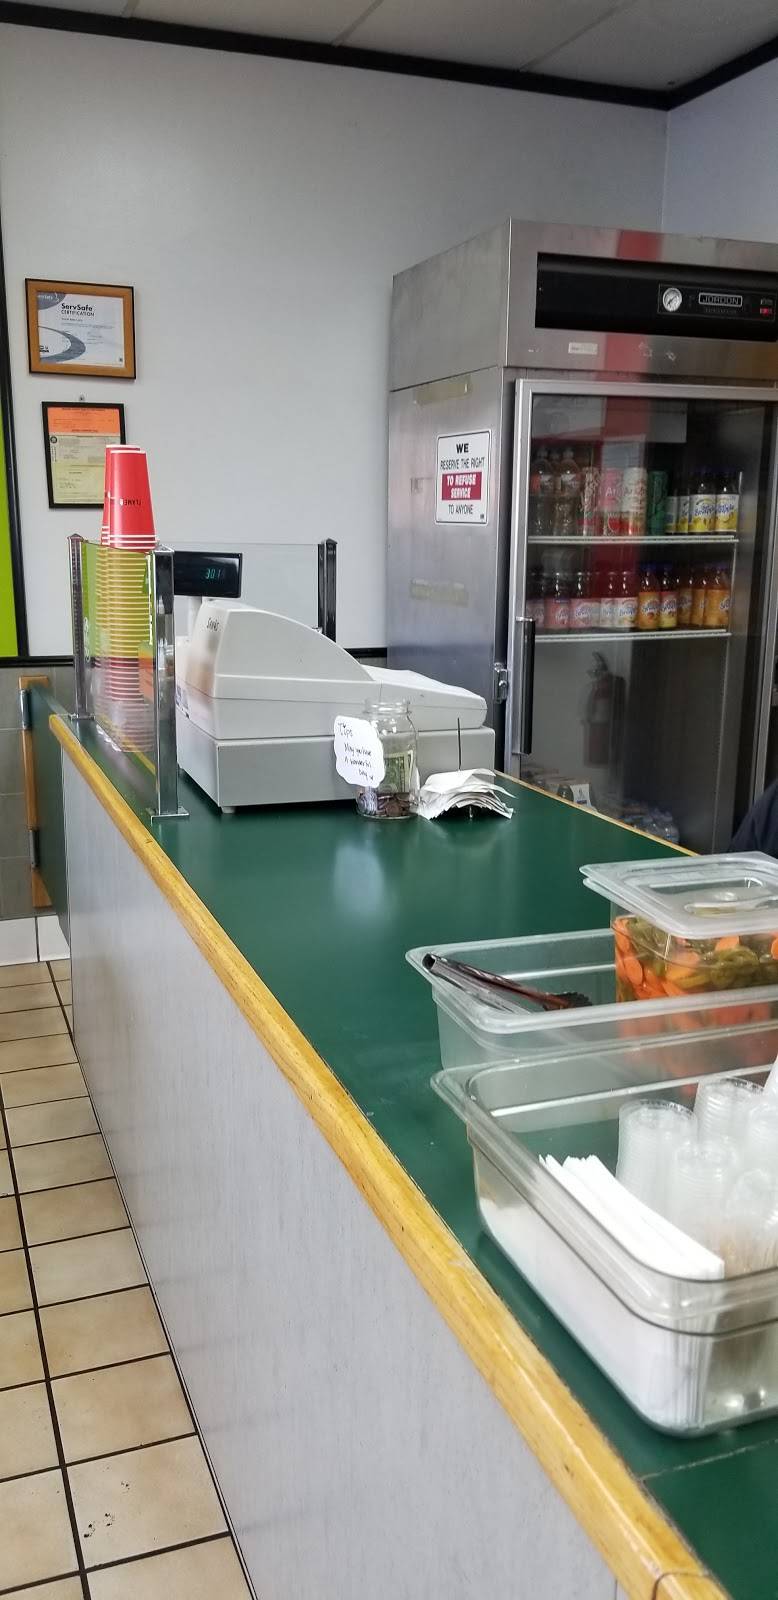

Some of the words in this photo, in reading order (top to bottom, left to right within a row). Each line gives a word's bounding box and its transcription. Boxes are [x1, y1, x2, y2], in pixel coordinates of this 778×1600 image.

[703, 295, 739, 305] JORDON
[61, 302, 93, 312] ServSafe
[61, 309, 95, 317] CERTIFICATION
[456, 443, 469, 453] WE
[440, 459, 459, 470] RESERVE
[461, 458, 470, 469] THE
[470, 457, 485, 468] RIGHT
[447, 475, 454, 487] TO
[455, 474, 476, 486] REFUSE
[451, 487, 470, 498] SERVICE
[448, 504, 454, 515] TO
[455, 504, 473, 515] ANYONE
[338, 722, 353, 738] Tips
